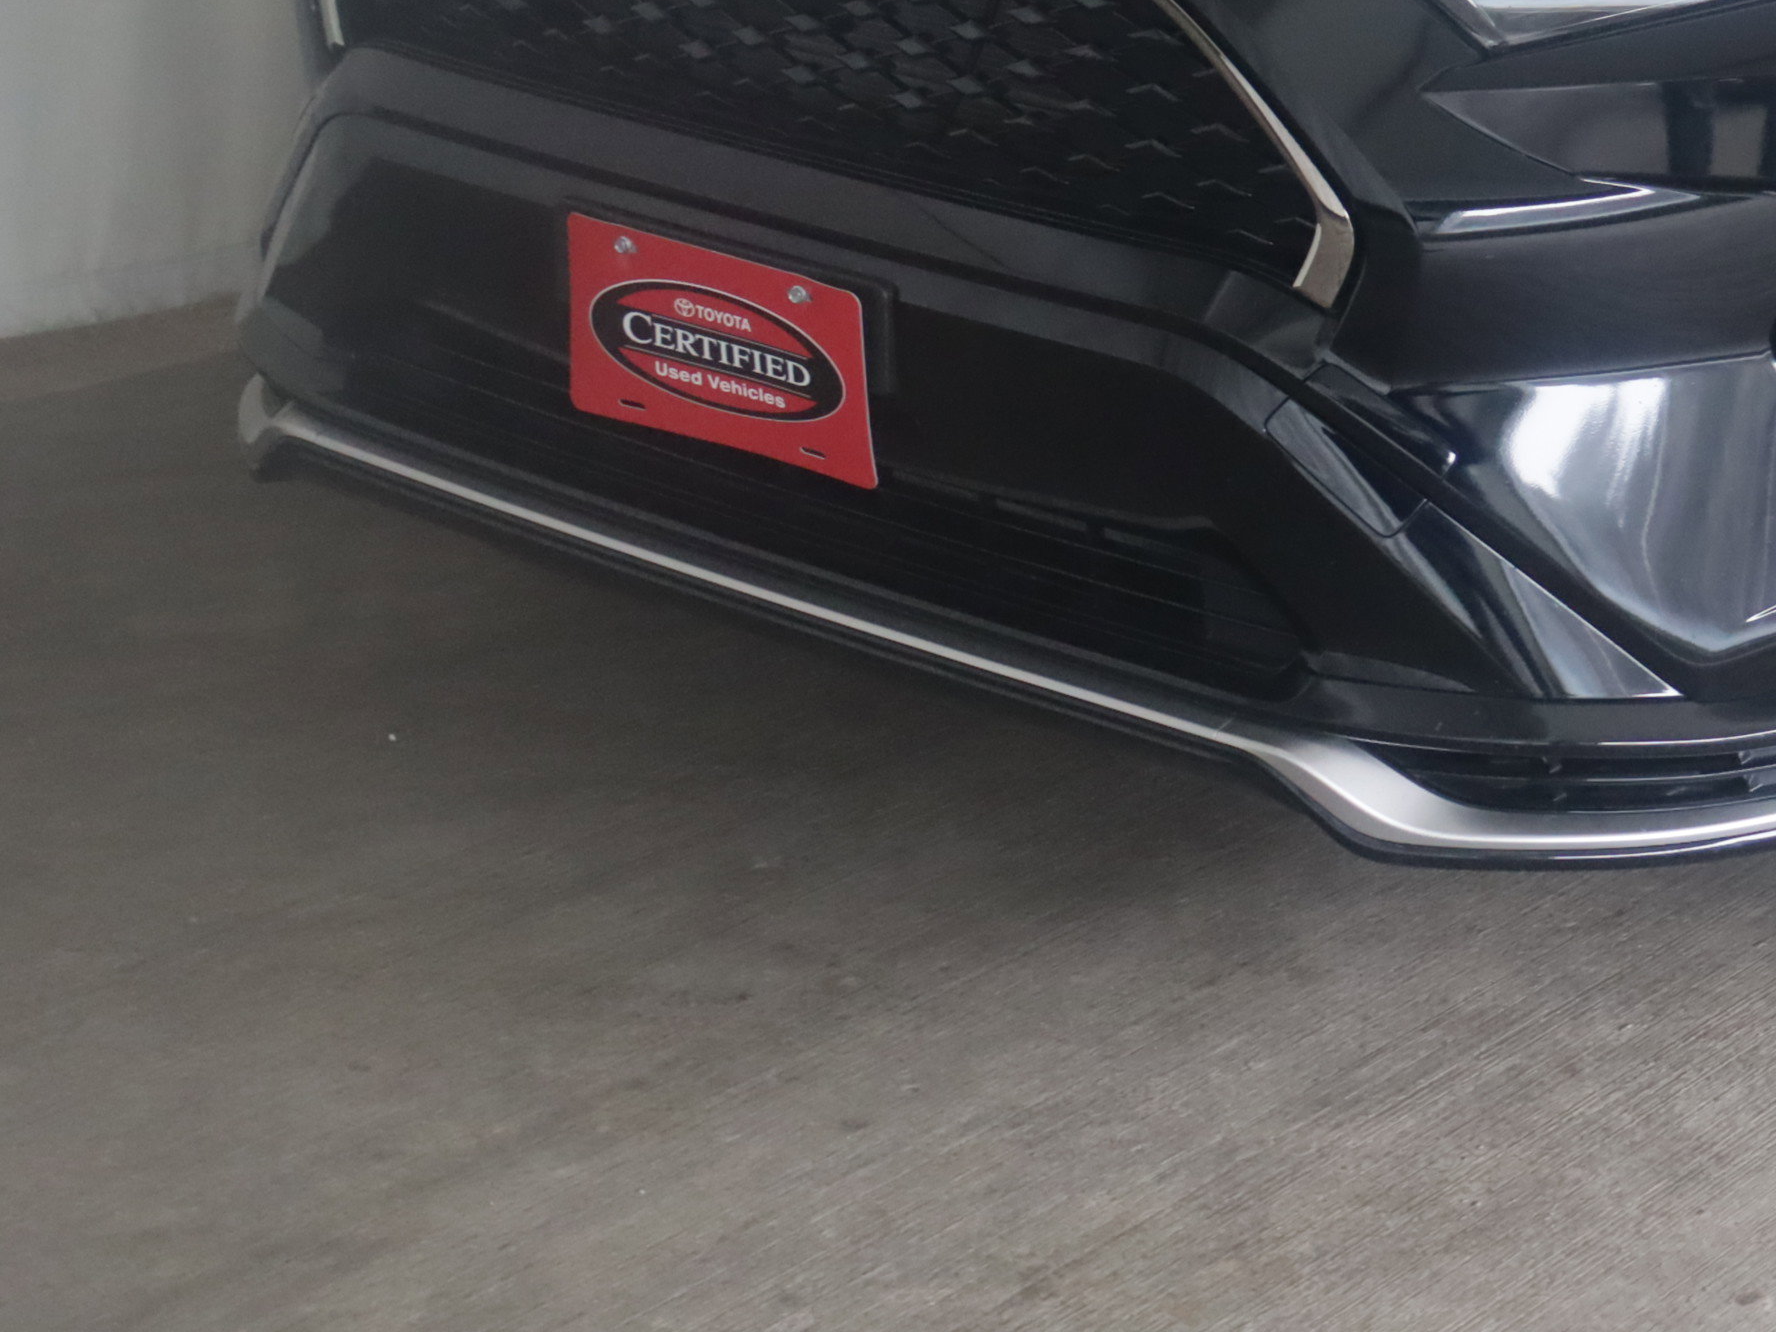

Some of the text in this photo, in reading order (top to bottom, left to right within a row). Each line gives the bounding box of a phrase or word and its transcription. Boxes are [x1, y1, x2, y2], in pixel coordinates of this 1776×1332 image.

[695, 305, 752, 332] TOYOTA
[622, 311, 811, 387] CERTIFIED
[655, 360, 786, 409] Used Vehicles
